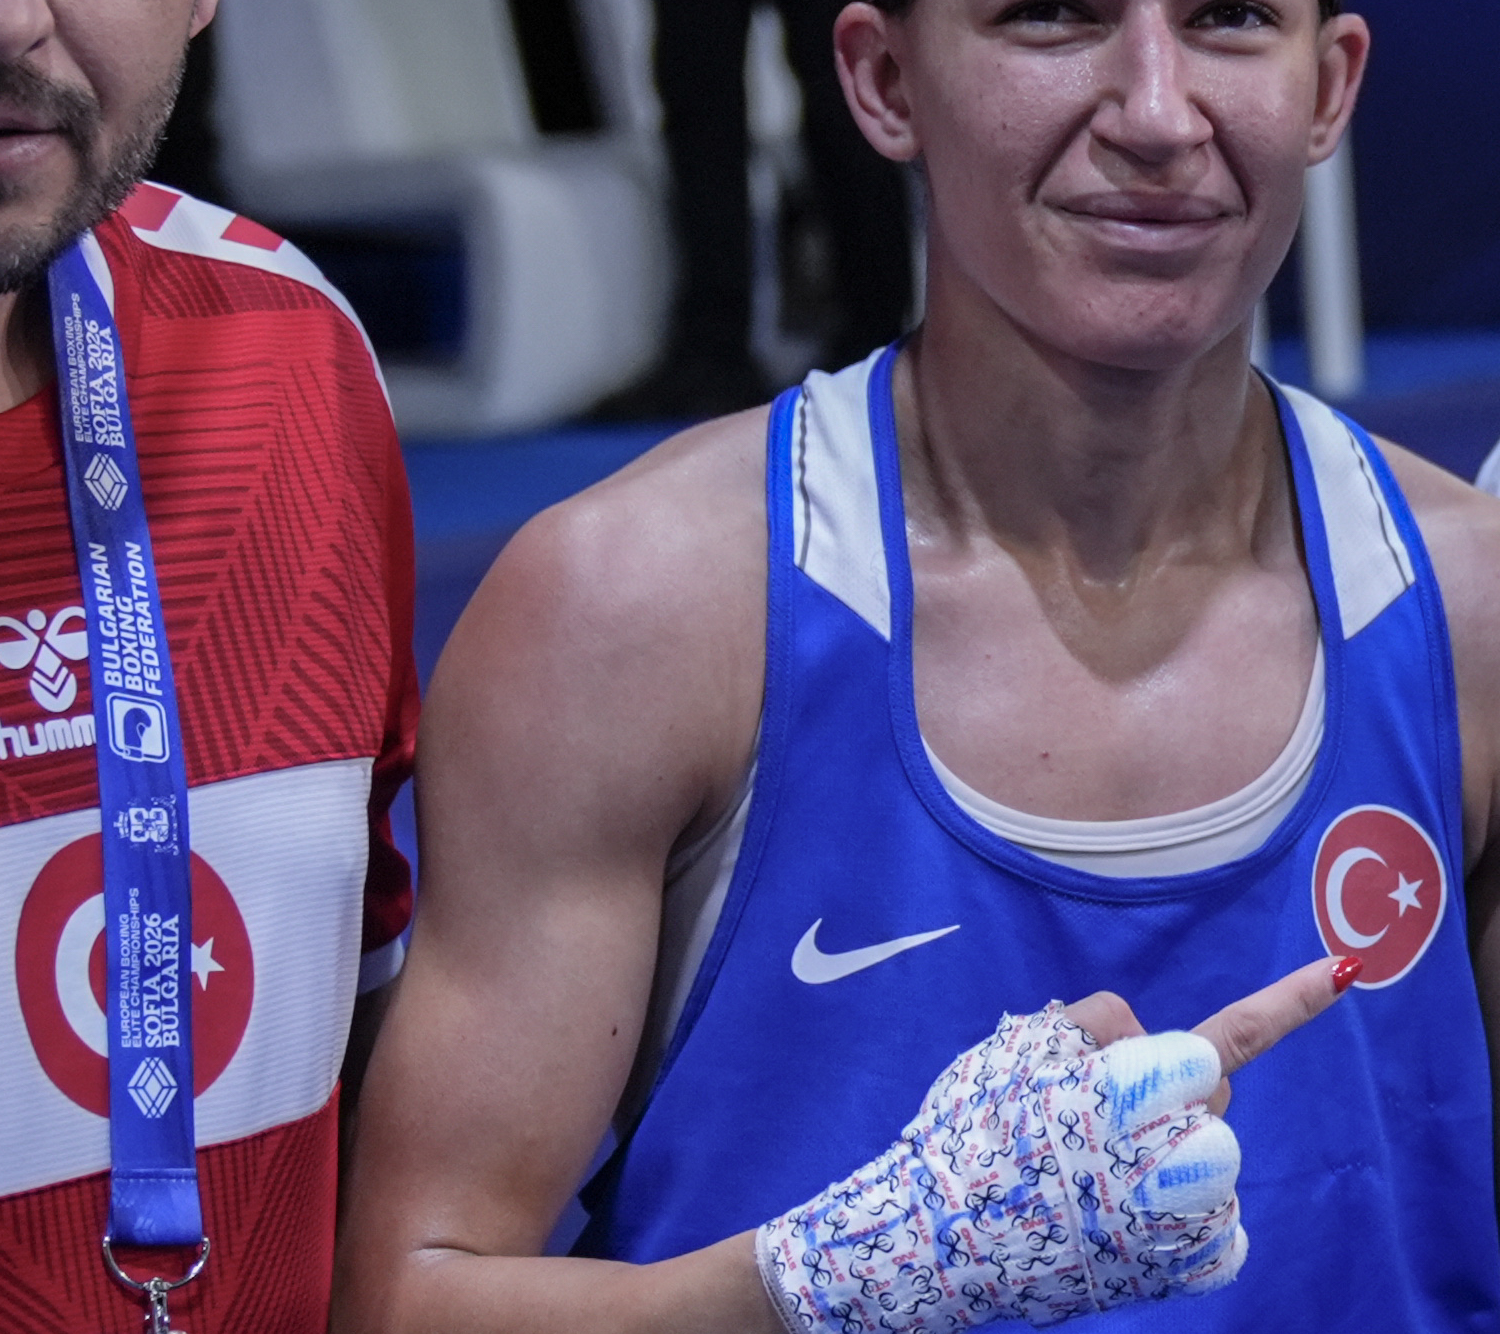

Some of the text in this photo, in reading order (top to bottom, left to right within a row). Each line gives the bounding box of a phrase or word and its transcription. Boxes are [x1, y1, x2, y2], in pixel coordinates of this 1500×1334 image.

[64, 316, 84, 442] EUROPEAN BOXING
[72, 293, 93, 443] ELITE CHAMPIONSHIPS
[84, 320, 110, 446] SOFIA 2026
[99, 326, 125, 448] BULGARIA
[88, 542, 123, 687] BULGARIAN
[125, 542, 163, 695] FEDERATION
[115, 596, 143, 691] BOXING
[119, 914, 131, 1048] EUROPEAN BOXING
[129, 888, 142, 1048] ELITE CHAMPIONSHIPS
[143, 913, 162, 1048] SOFIA 2026
[161, 914, 179, 1047] BULGARIA
[1082, 1111, 1098, 1153] STING
[1131, 1114, 1171, 1142] STING
[1013, 1142, 1051, 1167] STING
[937, 1171, 959, 1210] STING
[1005, 1192, 1043, 1216] STING
[1096, 1172, 1114, 1213] STING
[848, 1220, 887, 1239] STING
[910, 1203, 930, 1245] STING
[1022, 1212, 1063, 1230] STING
[782, 1239, 796, 1271] STING
[821, 1244, 845, 1282] STING
[961, 1228, 984, 1266] STING
[1113, 1230, 1131, 1264] STING
[934, 1261, 954, 1298] STING
[800, 1286, 825, 1322] STING
[852, 1298, 875, 1331] STING
